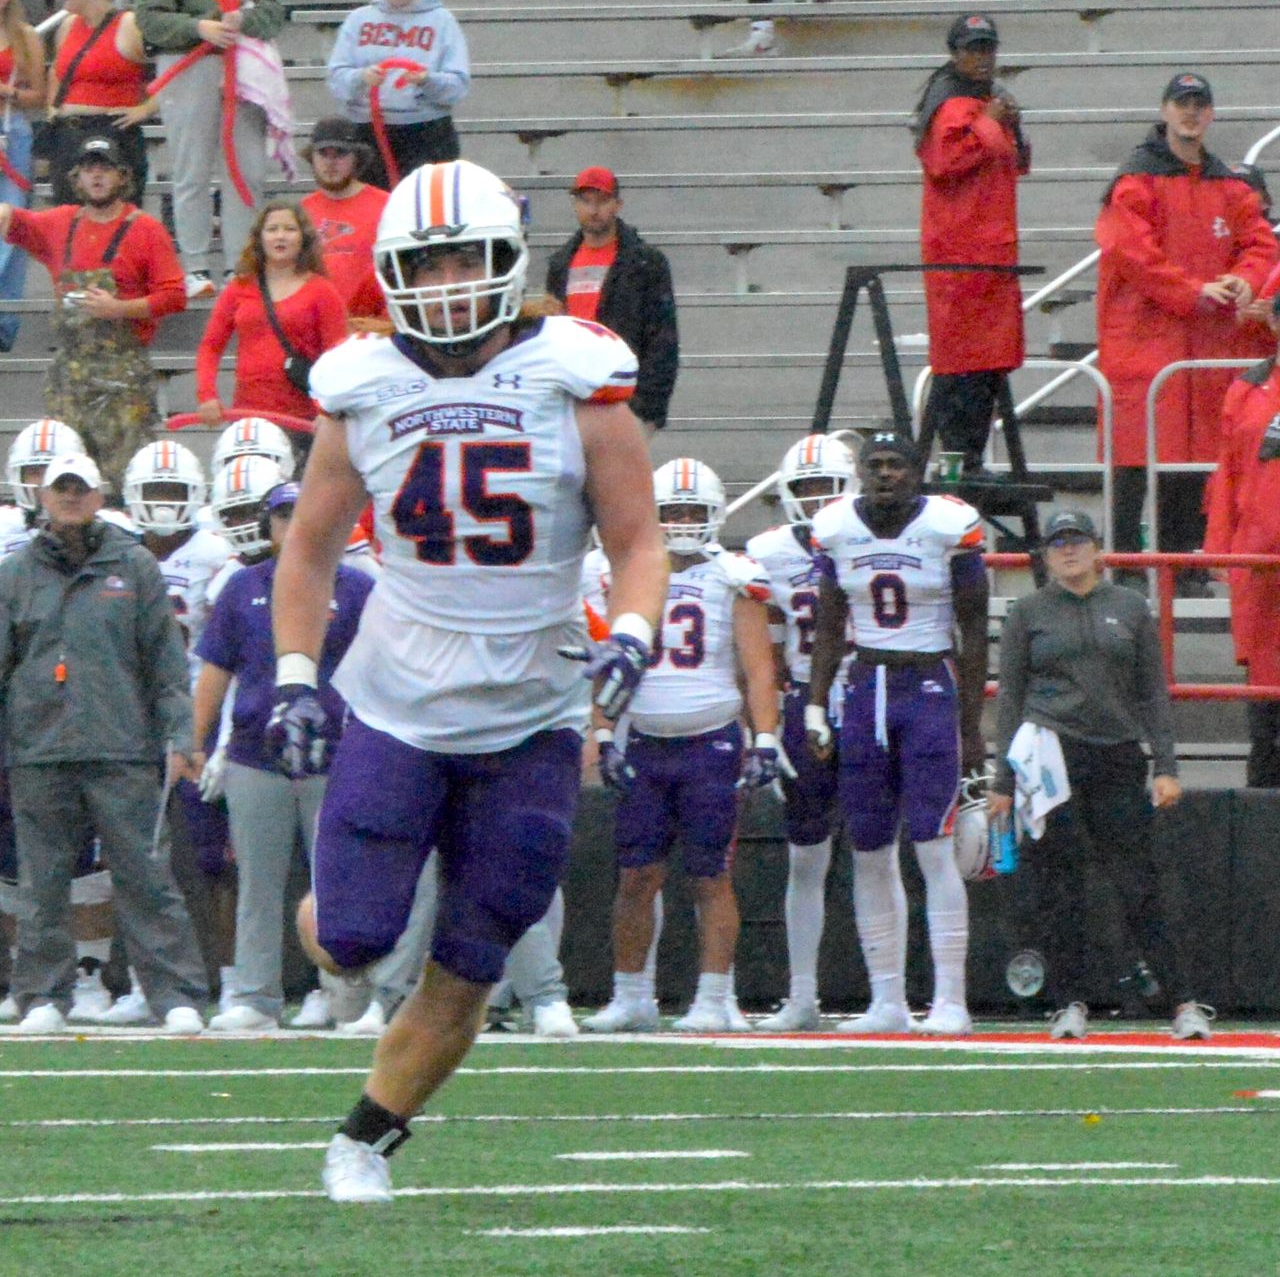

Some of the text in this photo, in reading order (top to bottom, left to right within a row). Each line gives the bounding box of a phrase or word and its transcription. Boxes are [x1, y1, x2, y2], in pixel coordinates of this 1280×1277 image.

[357, 21, 436, 52] SEMO
[393, 406, 518, 434] NORTHWESTERN
[430, 418, 479, 432] STATE
[391, 442, 534, 566] 45
[869, 572, 909, 629] 0
[647, 602, 706, 669] 3
